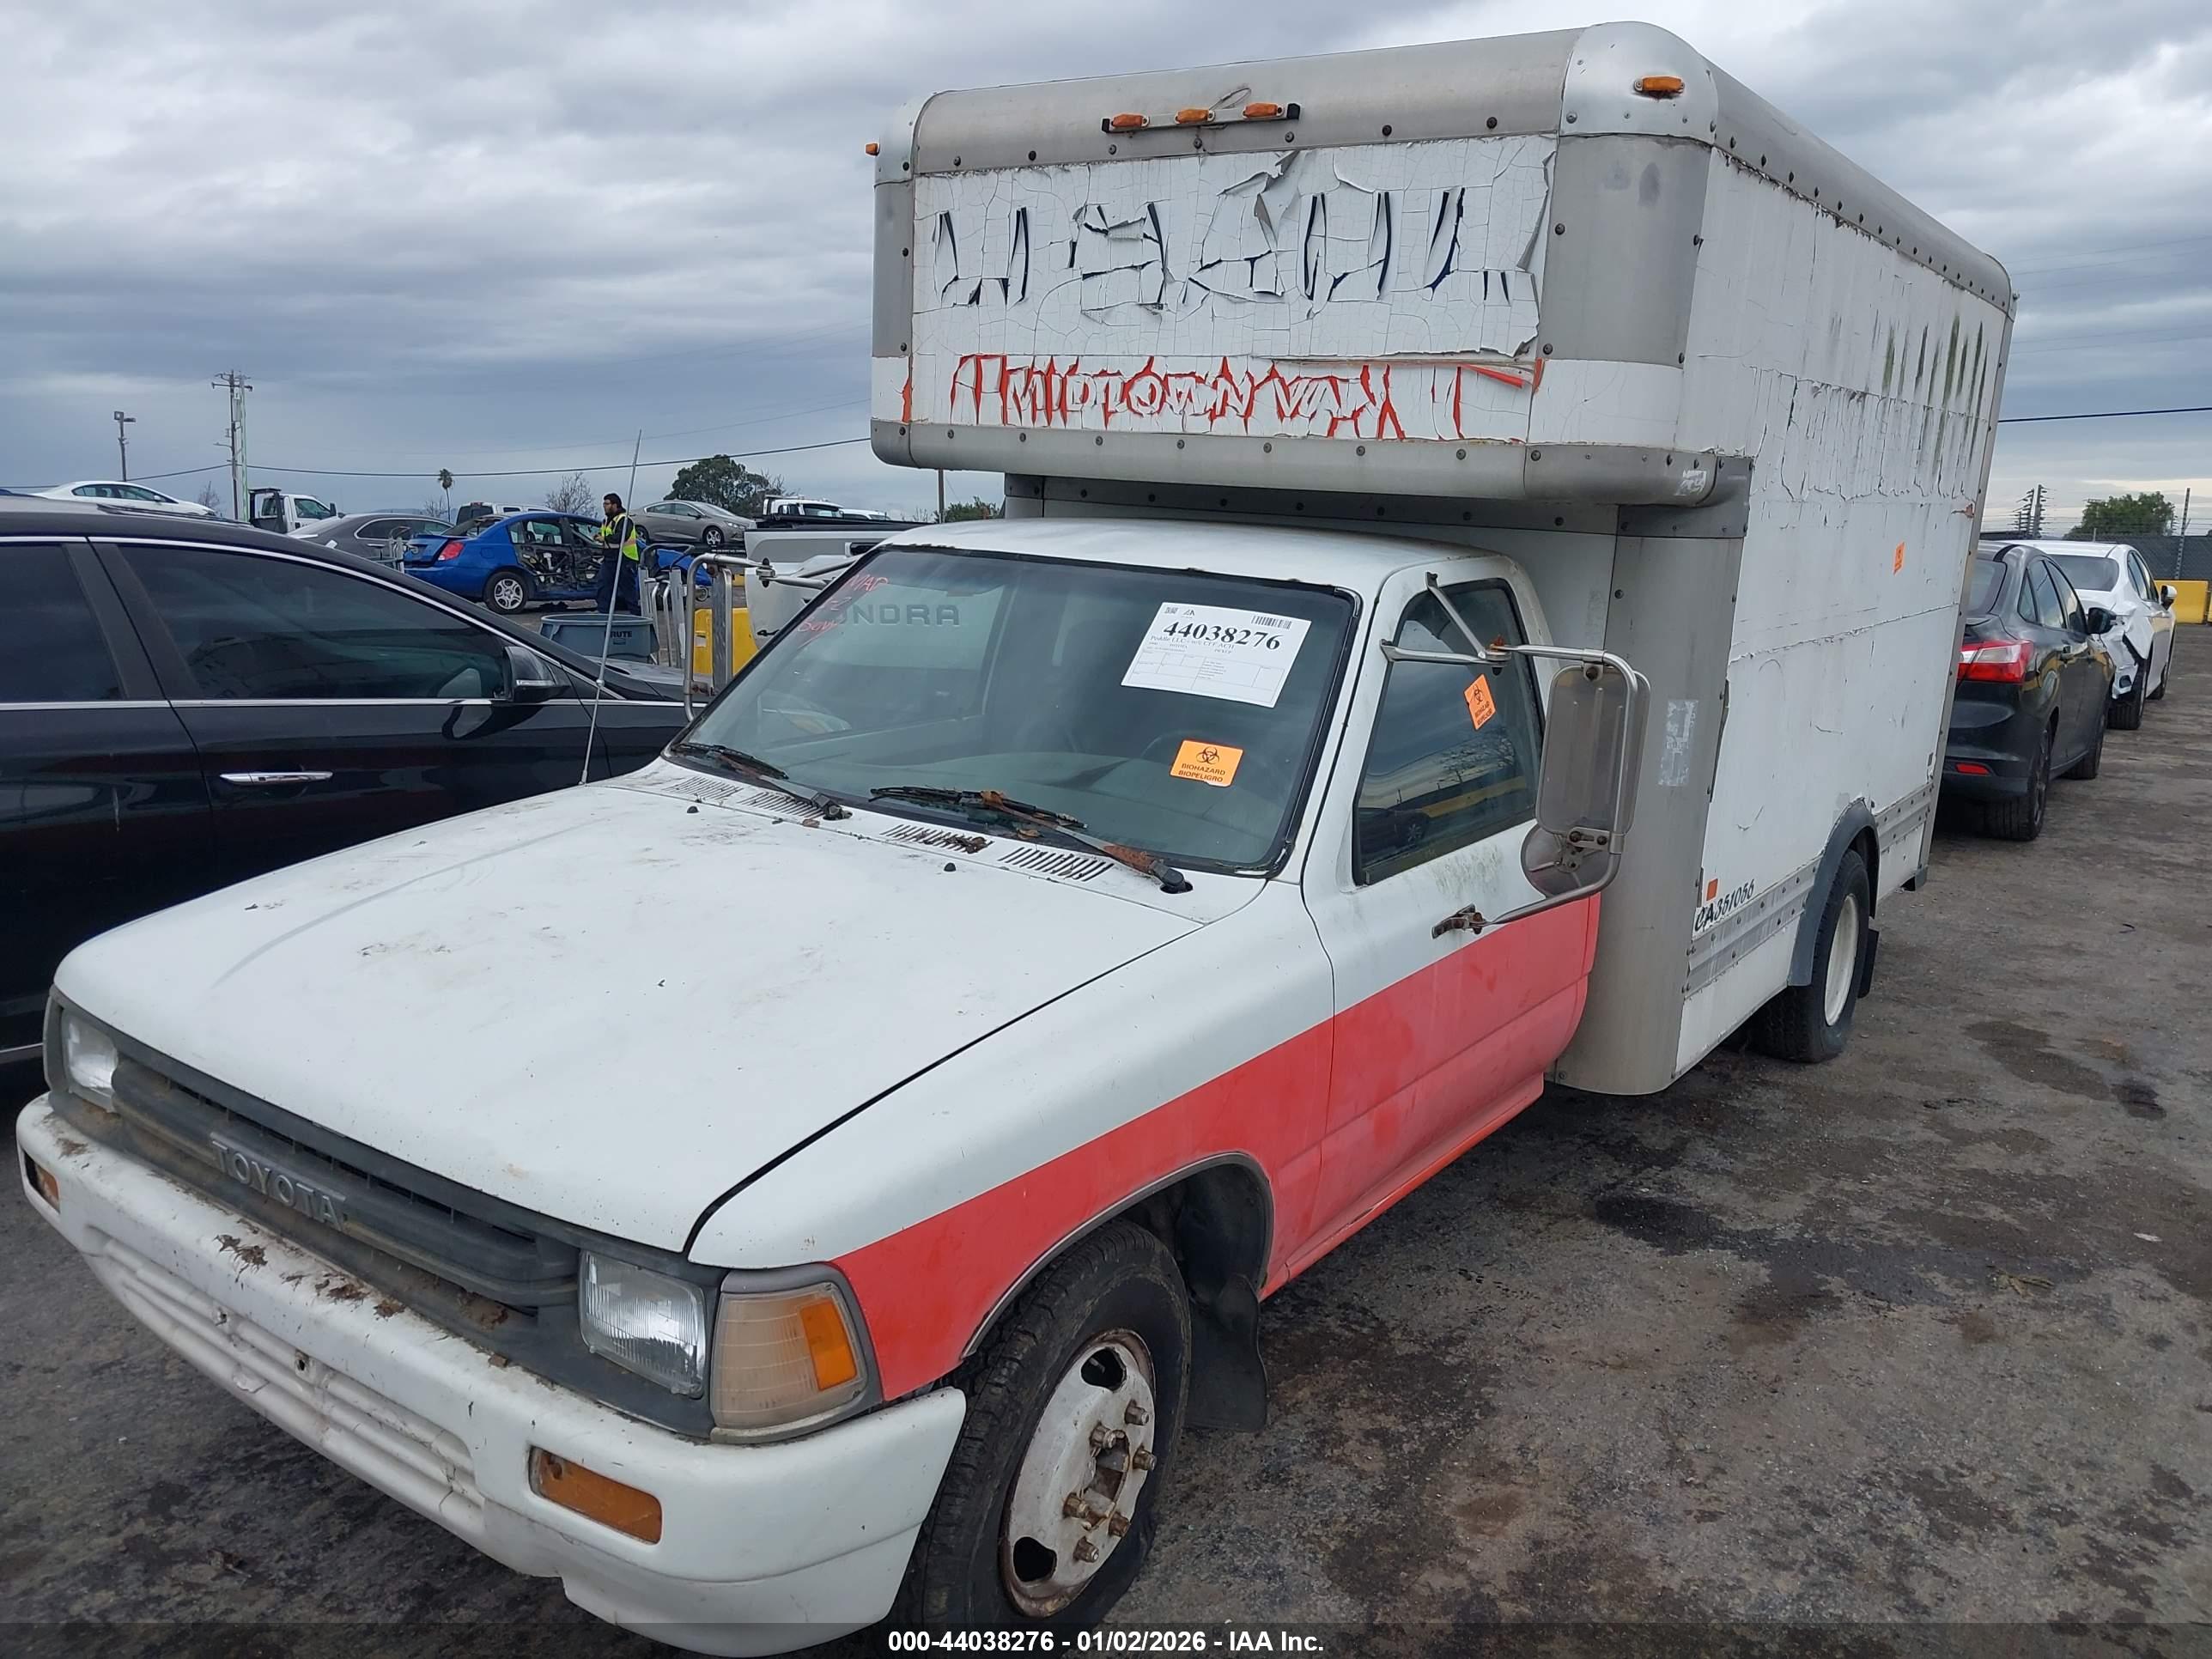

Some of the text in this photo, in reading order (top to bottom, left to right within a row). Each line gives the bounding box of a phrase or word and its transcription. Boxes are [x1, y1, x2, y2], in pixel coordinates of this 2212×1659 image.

[1163, 621, 1285, 650] 44038276
[1178, 769, 1224, 782] BIOPELIGRO
[1182, 763, 1225, 775] BIOHAZARD
[211, 1139, 345, 1232] TOYOTA
